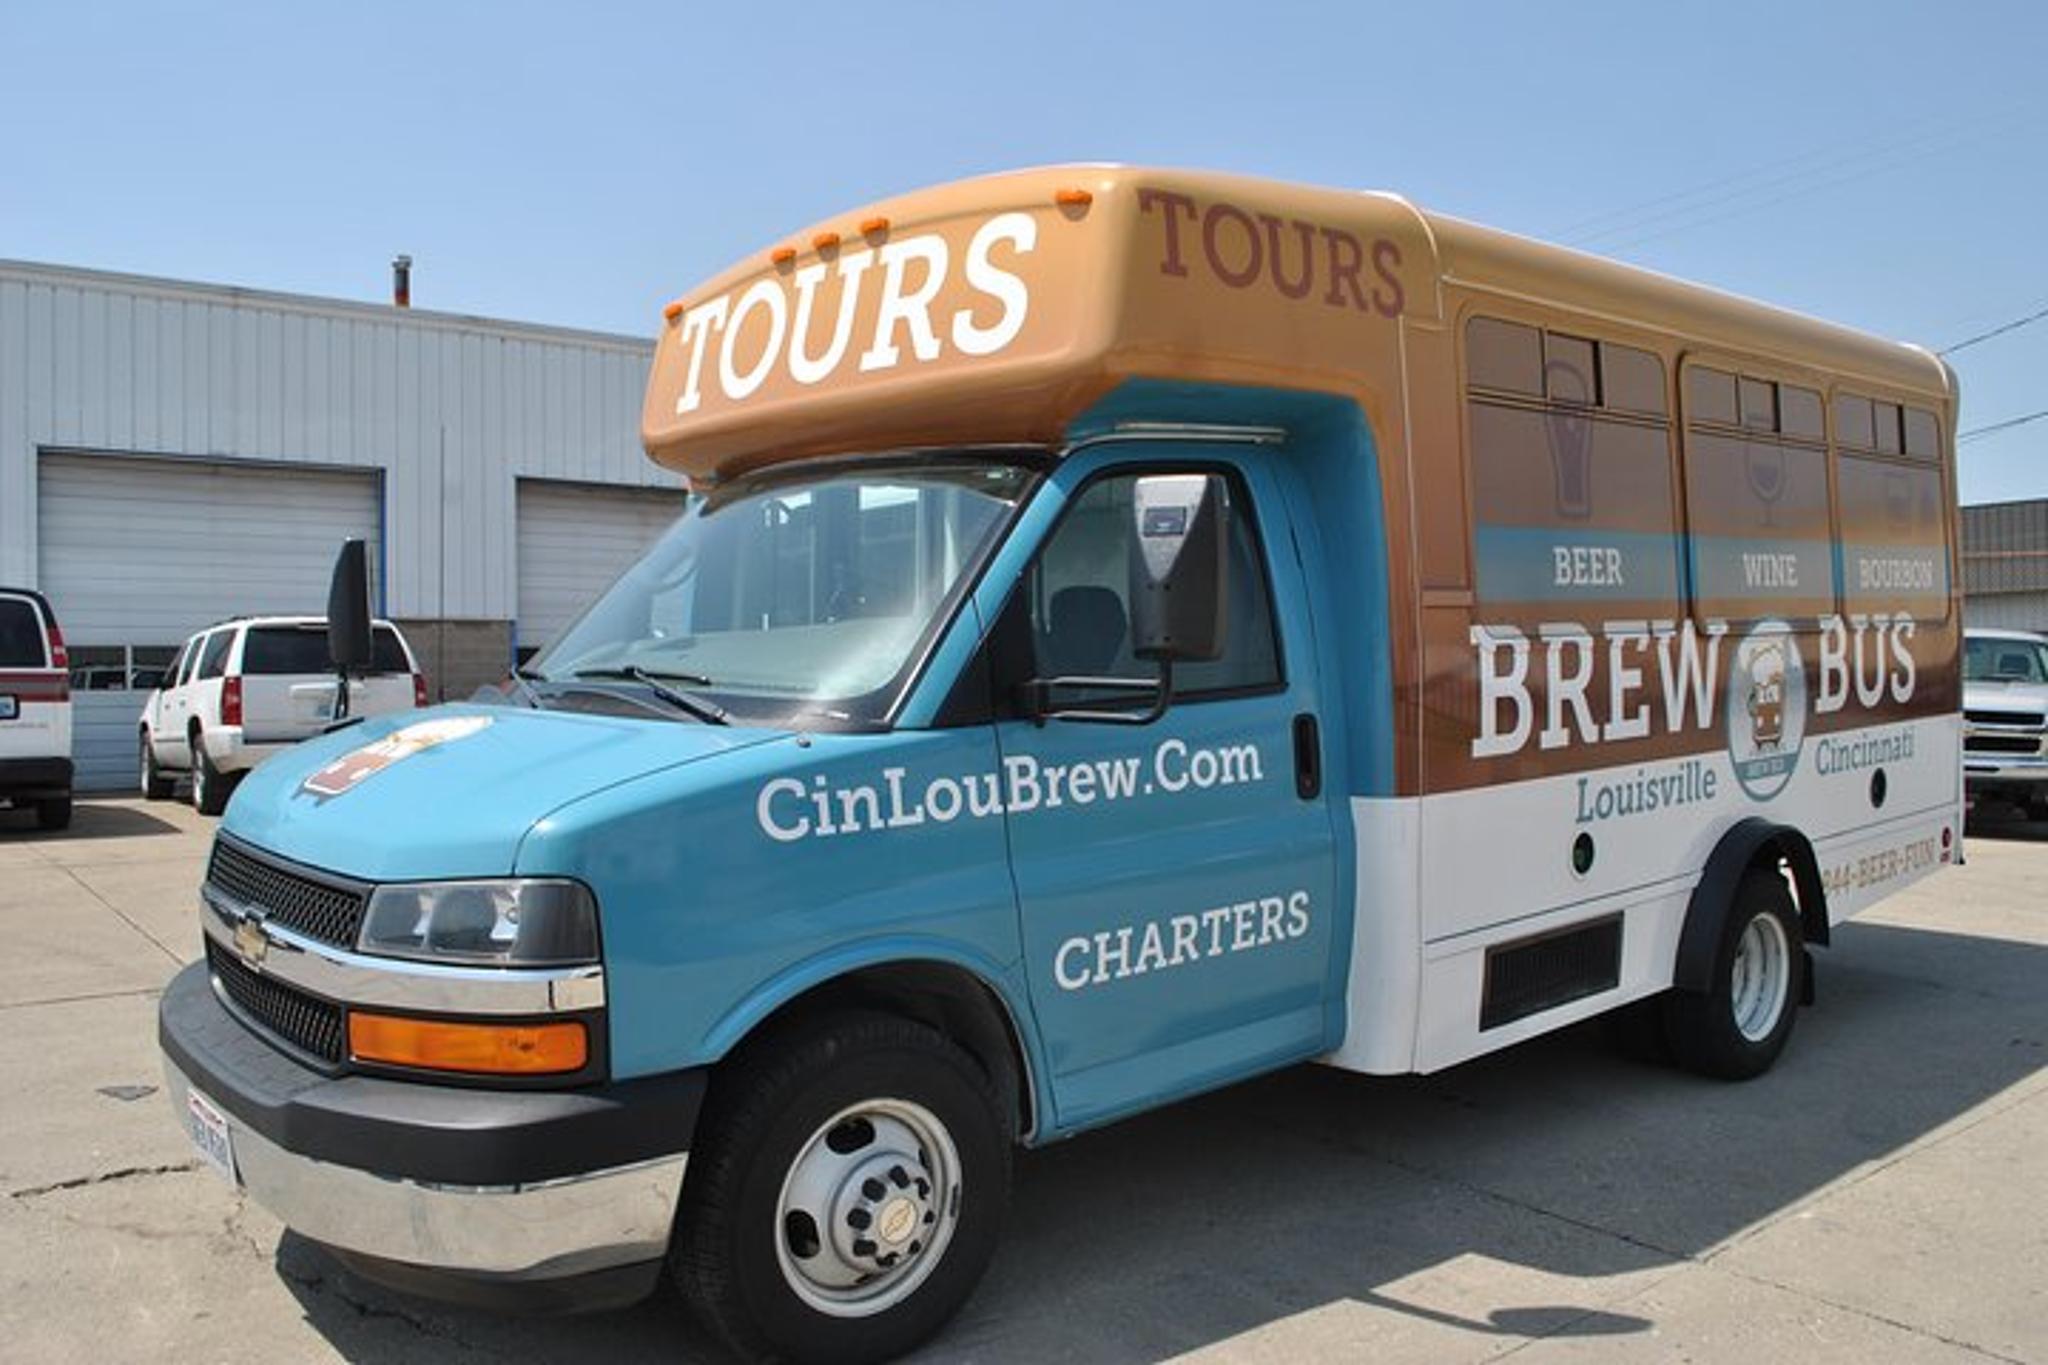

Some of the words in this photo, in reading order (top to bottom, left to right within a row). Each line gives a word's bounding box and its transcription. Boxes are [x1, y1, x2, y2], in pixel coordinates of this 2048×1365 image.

[1137, 186, 1404, 319] TOURS
[676, 212, 1037, 414] TOURS
[1553, 546, 1624, 586] BEER
[1742, 552, 1798, 588] WINE
[1859, 557, 1934, 590] BOURBON
[1470, 618, 1729, 758] BREW
[1814, 612, 1916, 714] BUS
[757, 739, 1263, 842] CinLouBrew.Com
[1816, 726, 1915, 776] Cincinnati
[1575, 761, 1717, 824] Louisville
[1054, 890, 1310, 990] CHARTERS
